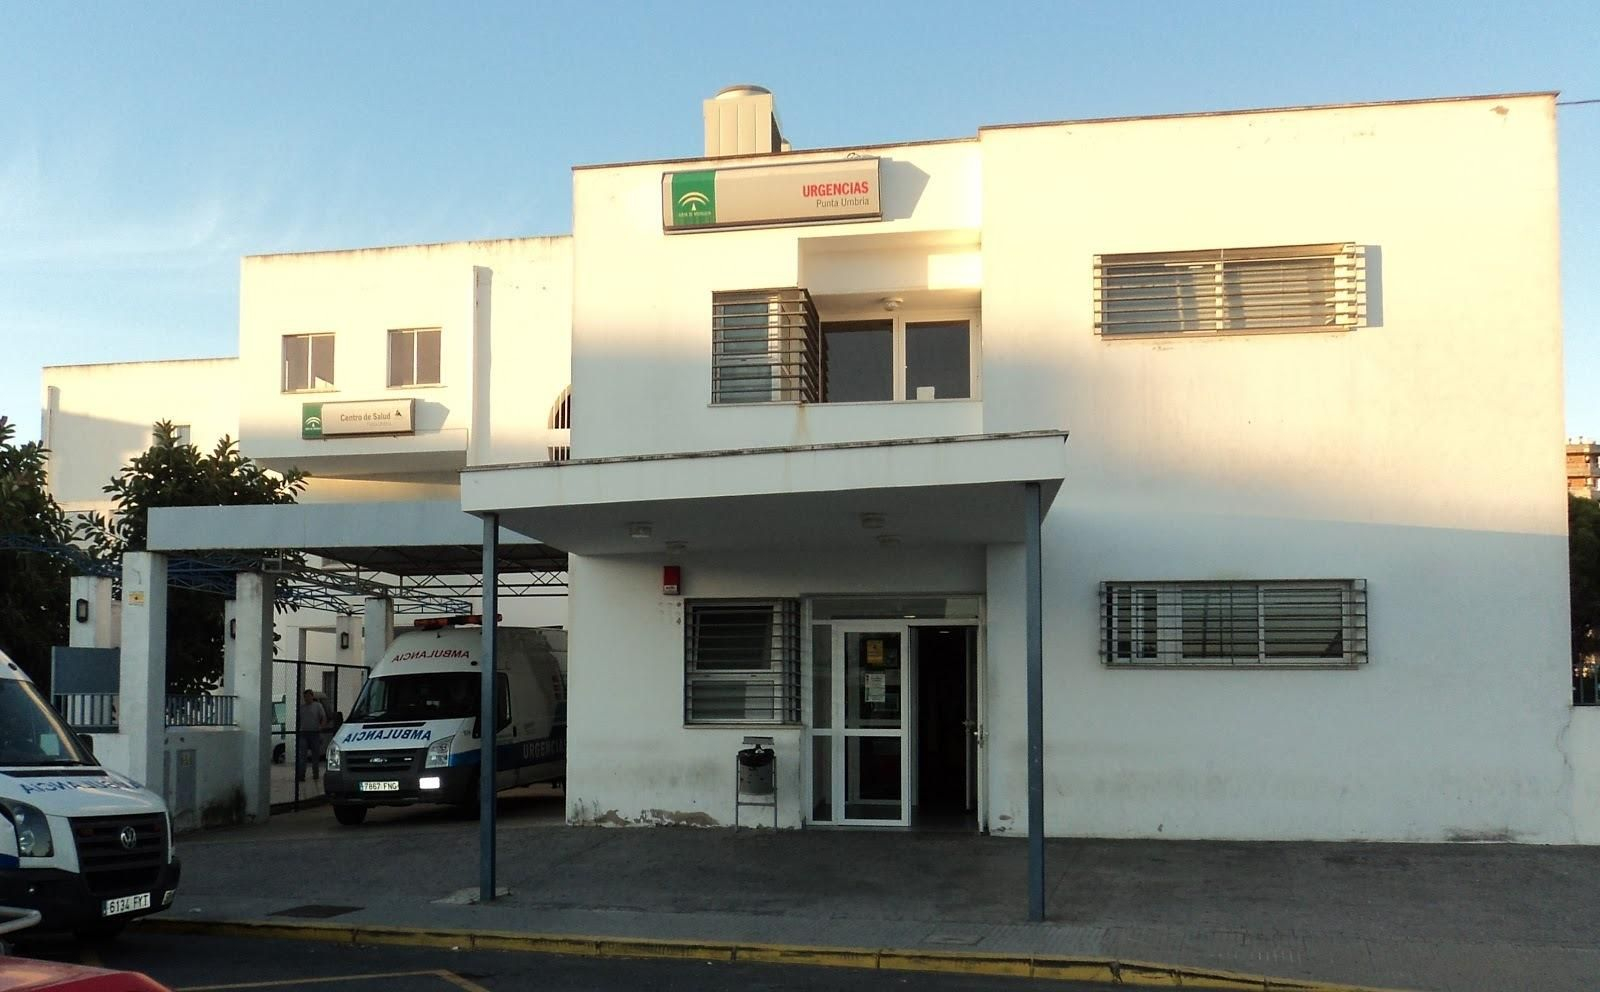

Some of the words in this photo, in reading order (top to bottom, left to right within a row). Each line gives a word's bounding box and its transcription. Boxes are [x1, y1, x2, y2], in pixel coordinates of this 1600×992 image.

[802, 181, 869, 197] URGENCIAS
[816, 199, 839, 208] Punta
[340, 414, 362, 422] Centro
[363, 413, 371, 421] de
[373, 412, 391, 420] Salud
[383, 782, 398, 790] FNG
[109, 899, 129, 913] 6134
[133, 894, 149, 910] FYT
